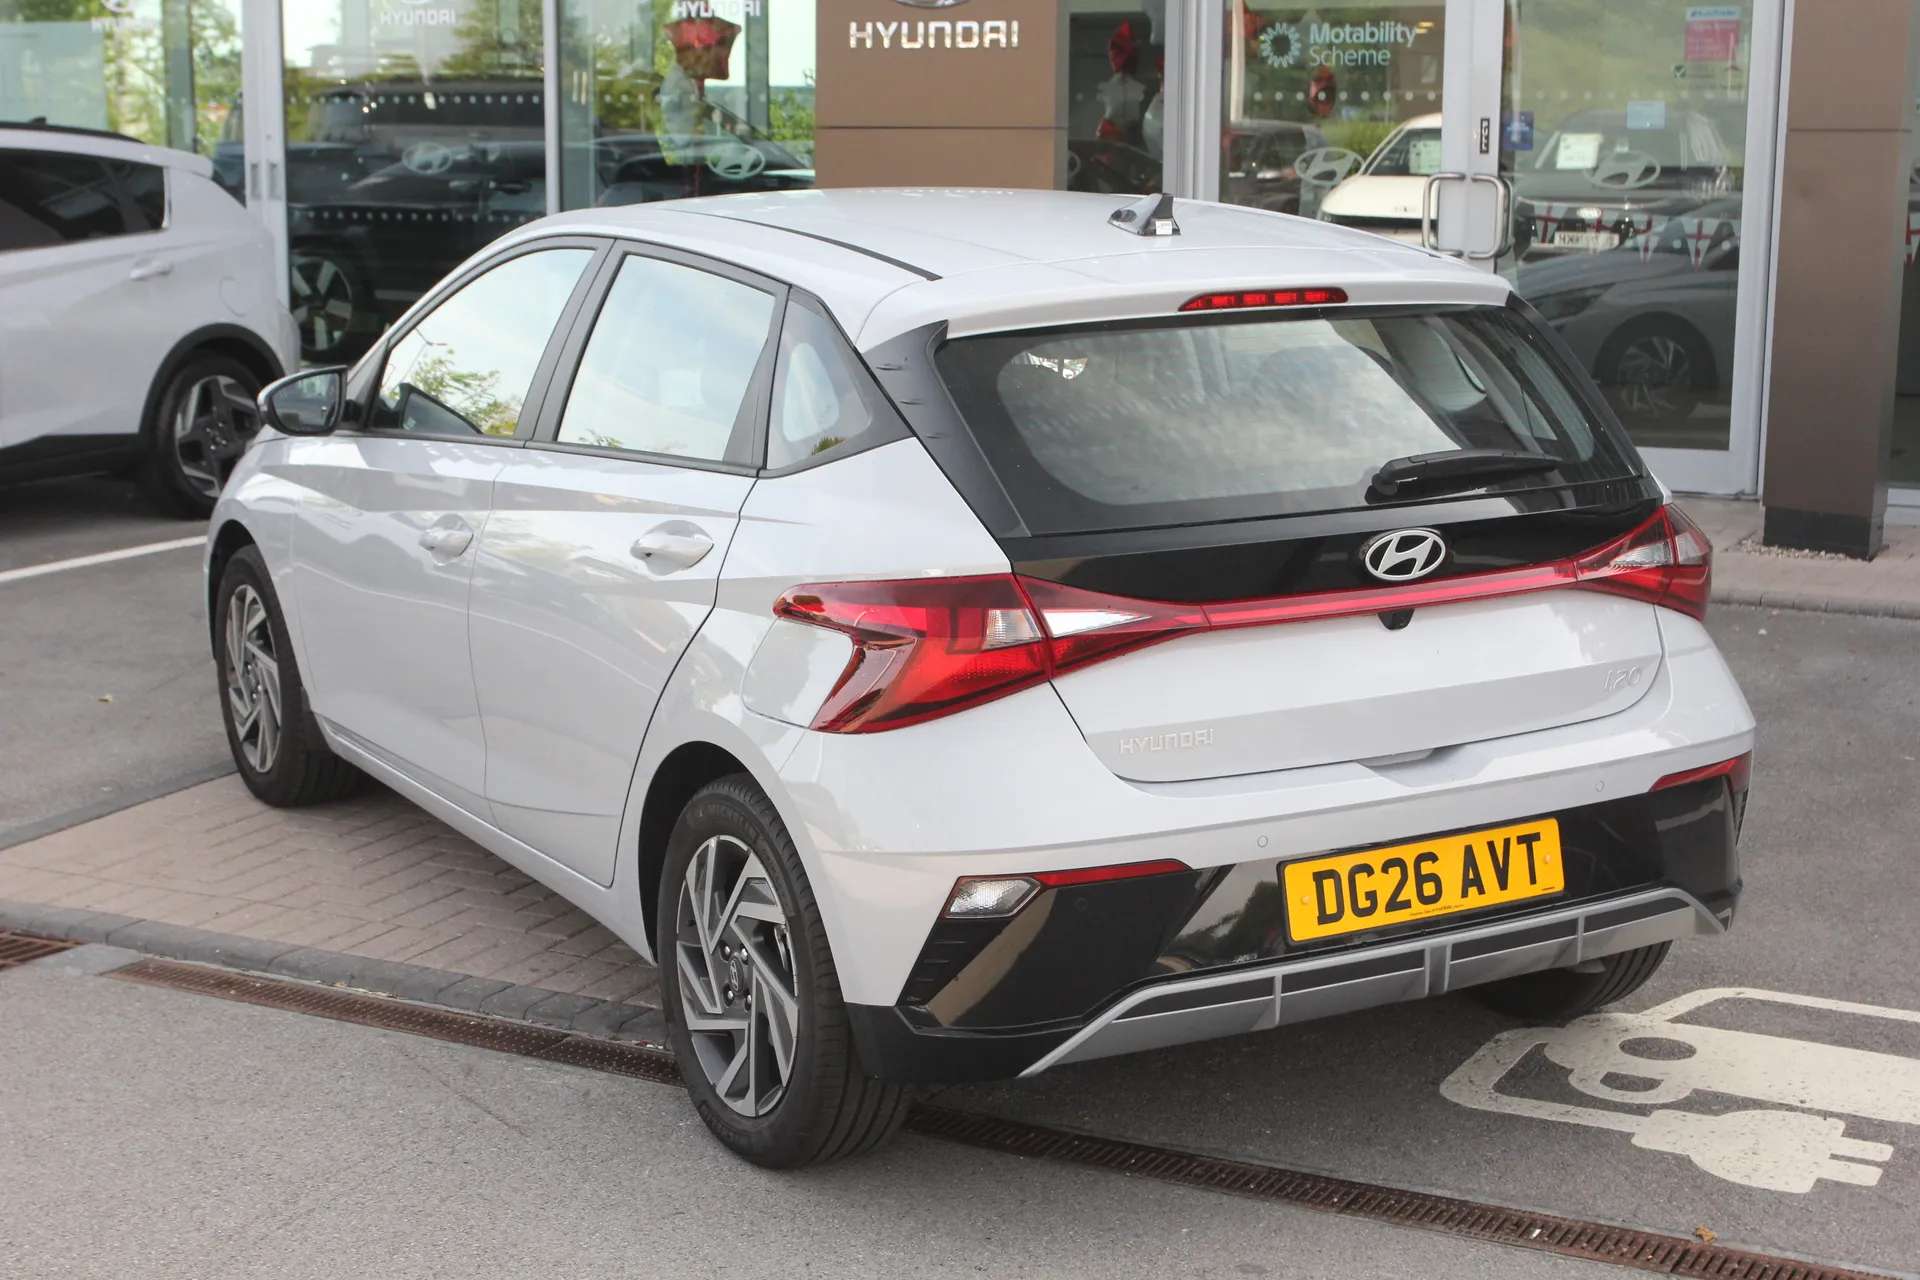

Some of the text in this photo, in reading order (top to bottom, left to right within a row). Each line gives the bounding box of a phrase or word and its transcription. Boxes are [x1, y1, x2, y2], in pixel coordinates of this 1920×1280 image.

[380, 8, 457, 25] HYUNDAI
[672, 0, 761, 18] HYUDAI
[849, 20, 1019, 49] HYUNDAI
[1309, 21, 1418, 48] Motability
[1310, 45, 1391, 67] Scheme
[1120, 728, 1214, 754] HYUNDAI
[1312, 832, 1541, 926] DG26 AVT
